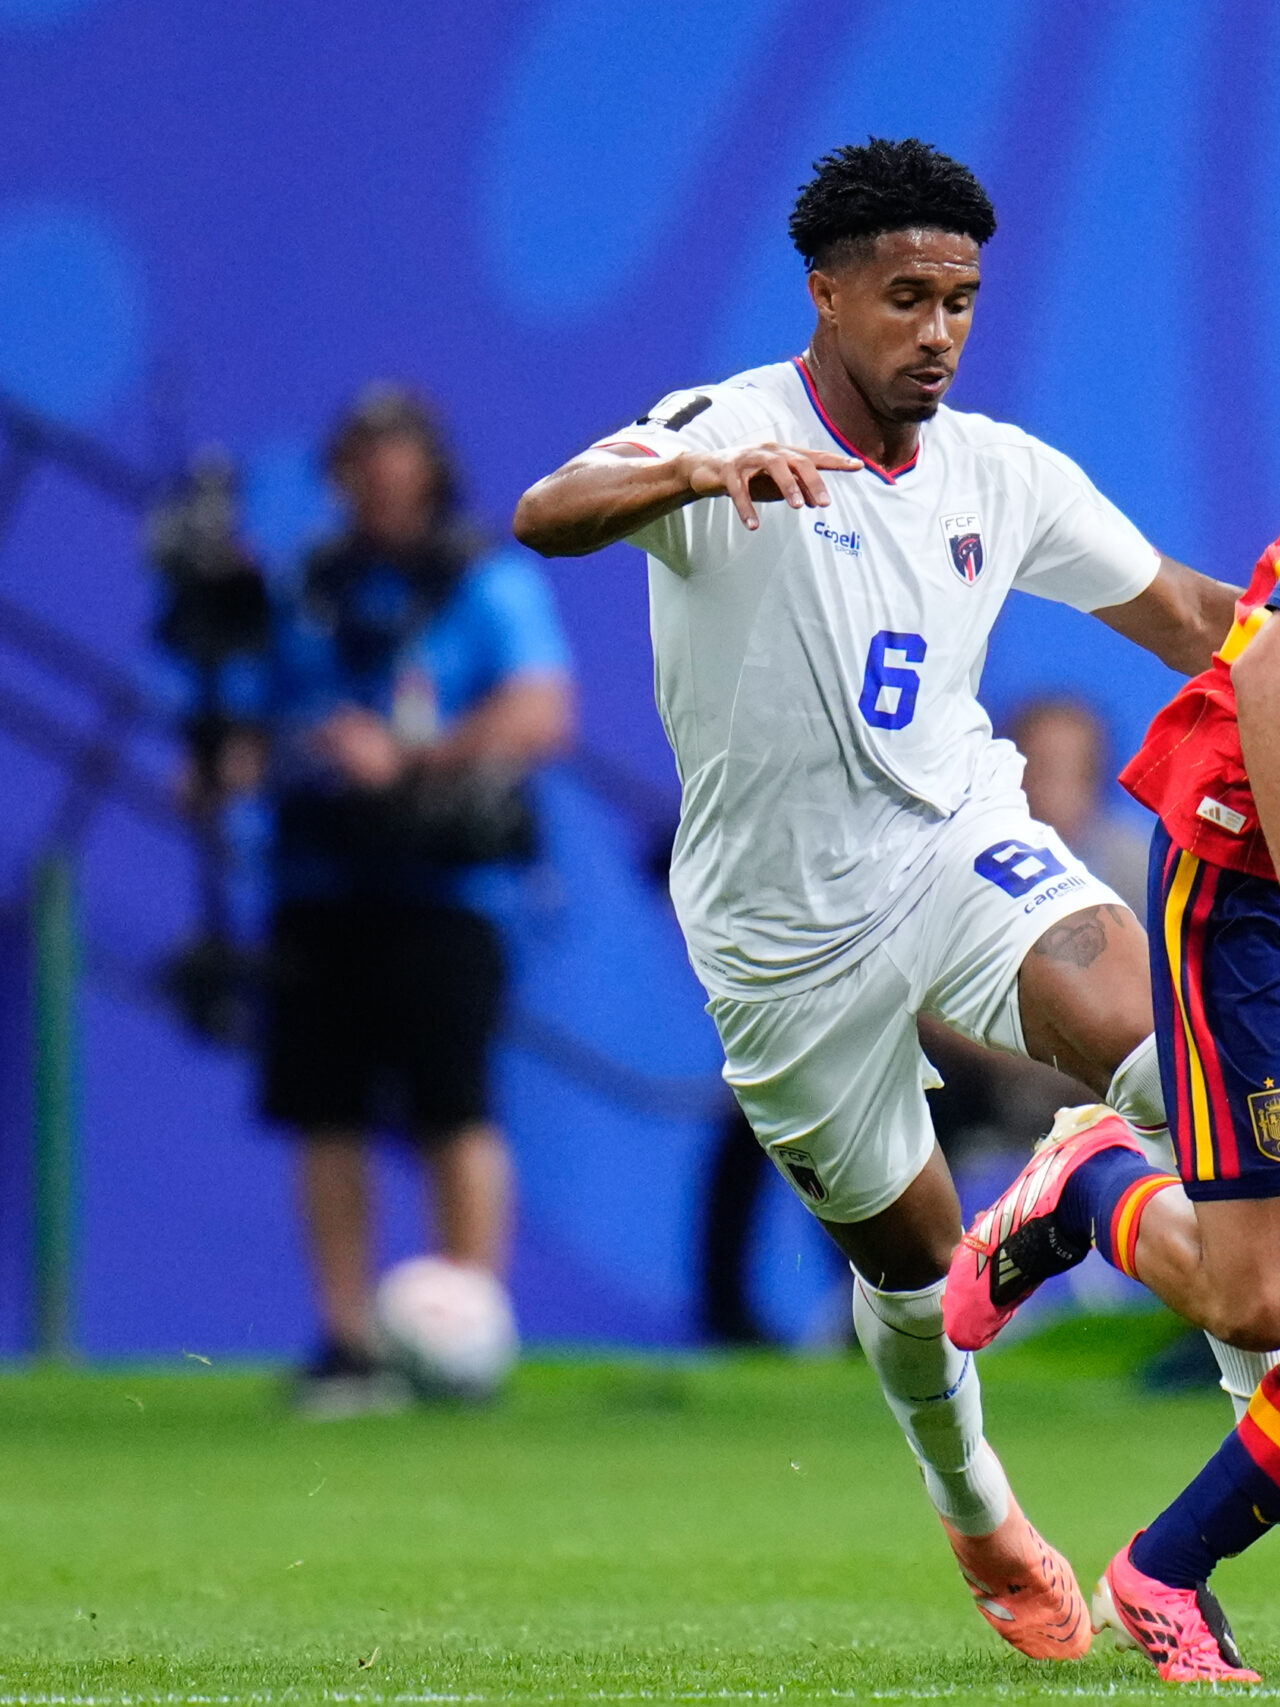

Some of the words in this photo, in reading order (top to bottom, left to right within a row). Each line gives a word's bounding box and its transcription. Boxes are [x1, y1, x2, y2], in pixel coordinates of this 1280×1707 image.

[944, 516, 976, 531] FCF
[858, 630, 928, 731] 6
[974, 839, 1067, 899] 6
[1024, 875, 1087, 914] capelli
